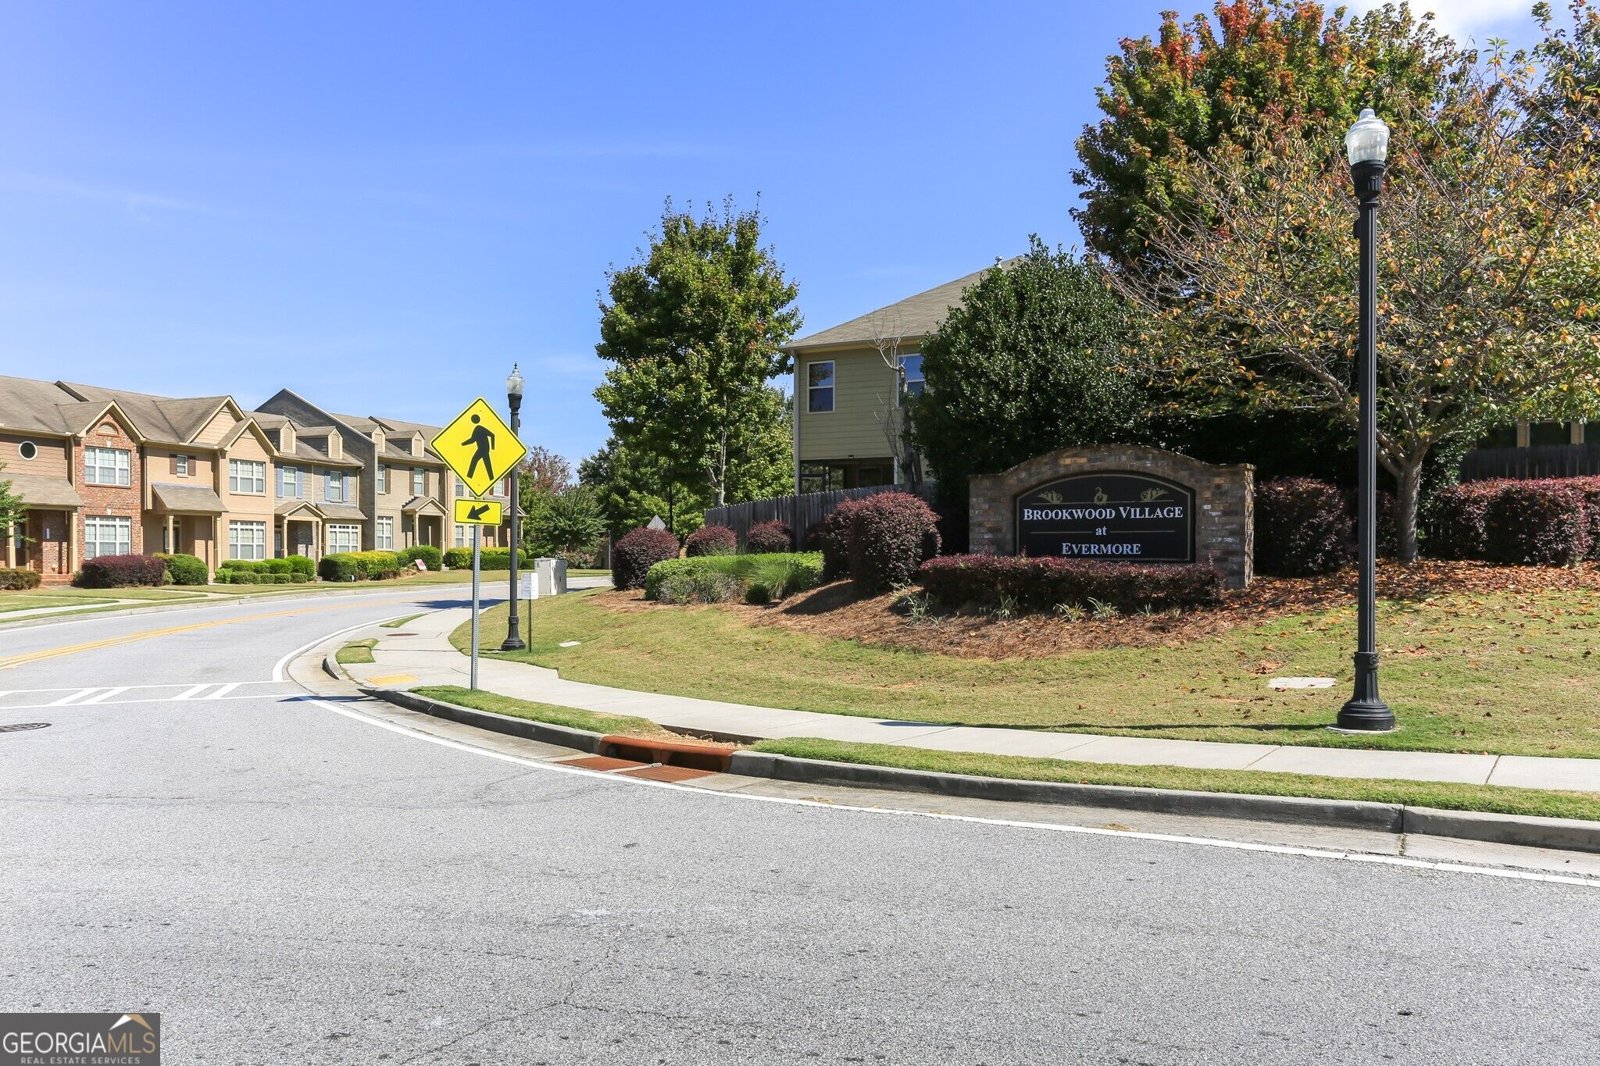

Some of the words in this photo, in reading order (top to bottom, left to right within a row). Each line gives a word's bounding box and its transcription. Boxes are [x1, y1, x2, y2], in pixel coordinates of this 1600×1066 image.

[1023, 508, 1115, 520] BROOKWOOD
[1119, 506, 1183, 519] VILLAGE
[1095, 526, 1108, 536] at
[1062, 543, 1141, 555] EVERMORE
